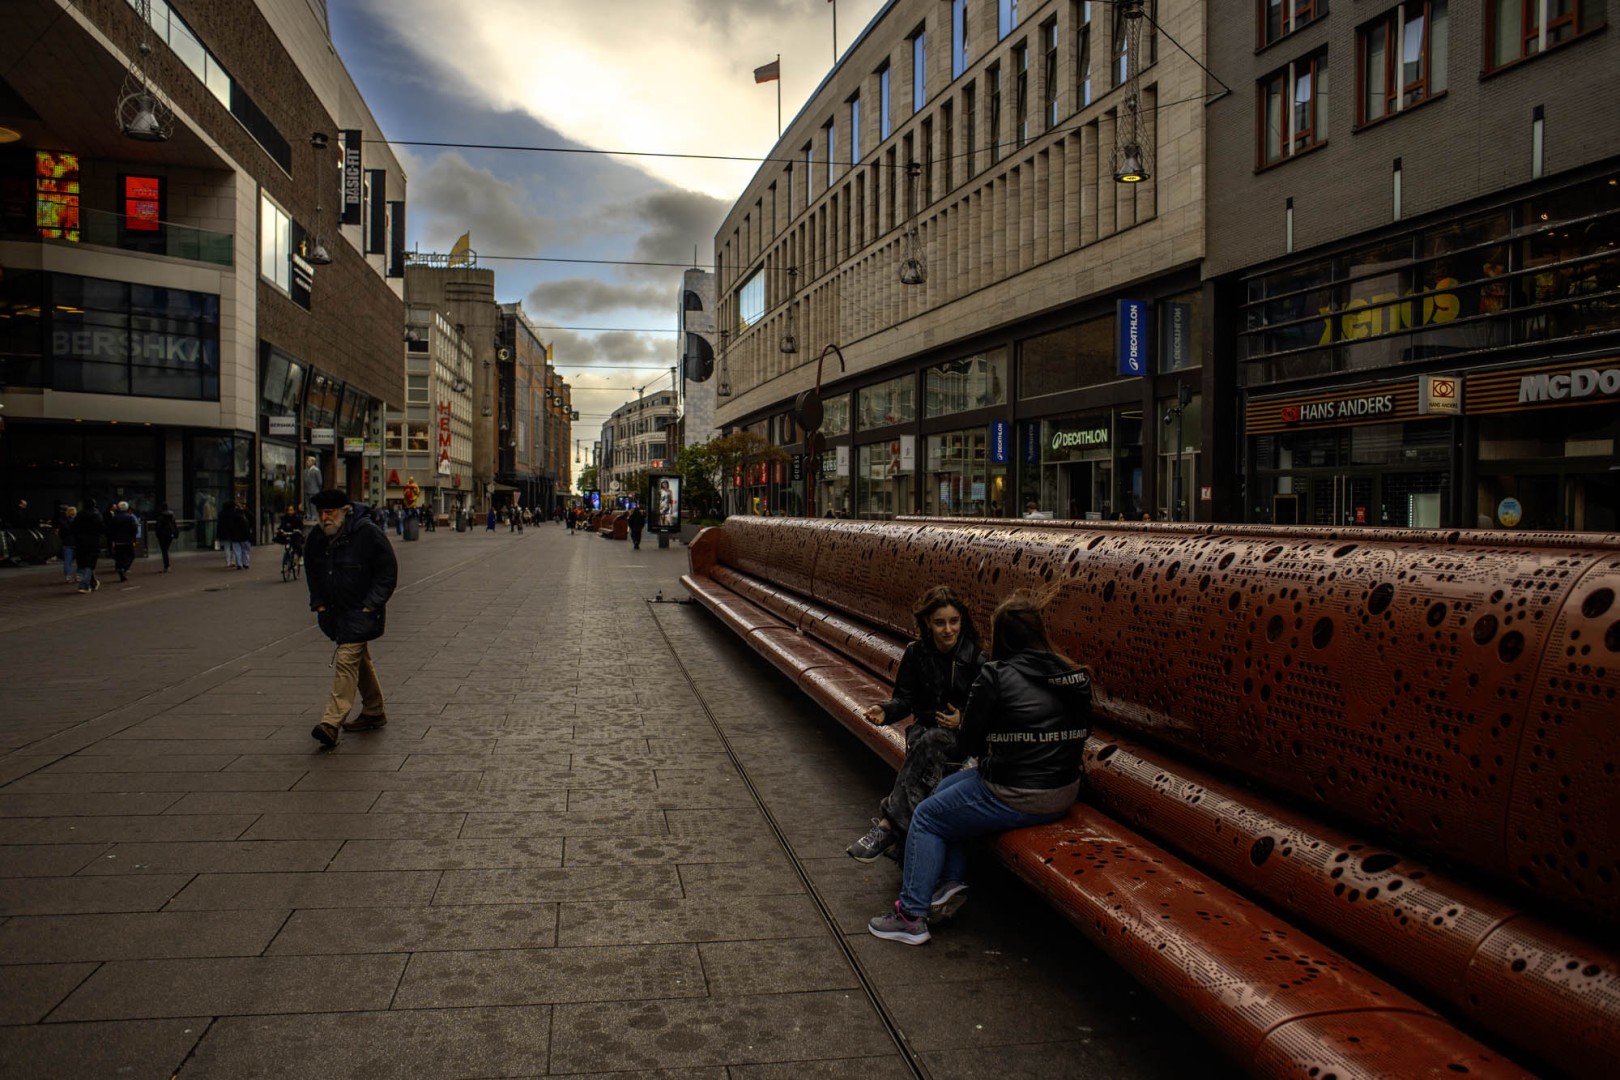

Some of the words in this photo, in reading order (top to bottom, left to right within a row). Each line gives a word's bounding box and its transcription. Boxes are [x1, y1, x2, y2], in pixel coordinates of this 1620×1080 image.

[346, 147, 360, 204] BASIC-FIT
[52, 330, 210, 364] BERSHKA
[1130, 304, 1138, 358] DECATHLON
[1300, 402, 1335, 421] HANS
[1337, 395, 1393, 417] ANDERS
[439, 401, 451, 463] HEMA
[1062, 428, 1108, 446] DECATHLON
[1040, 731, 1059, 743] LIFE
[1061, 730, 1068, 740] IS
